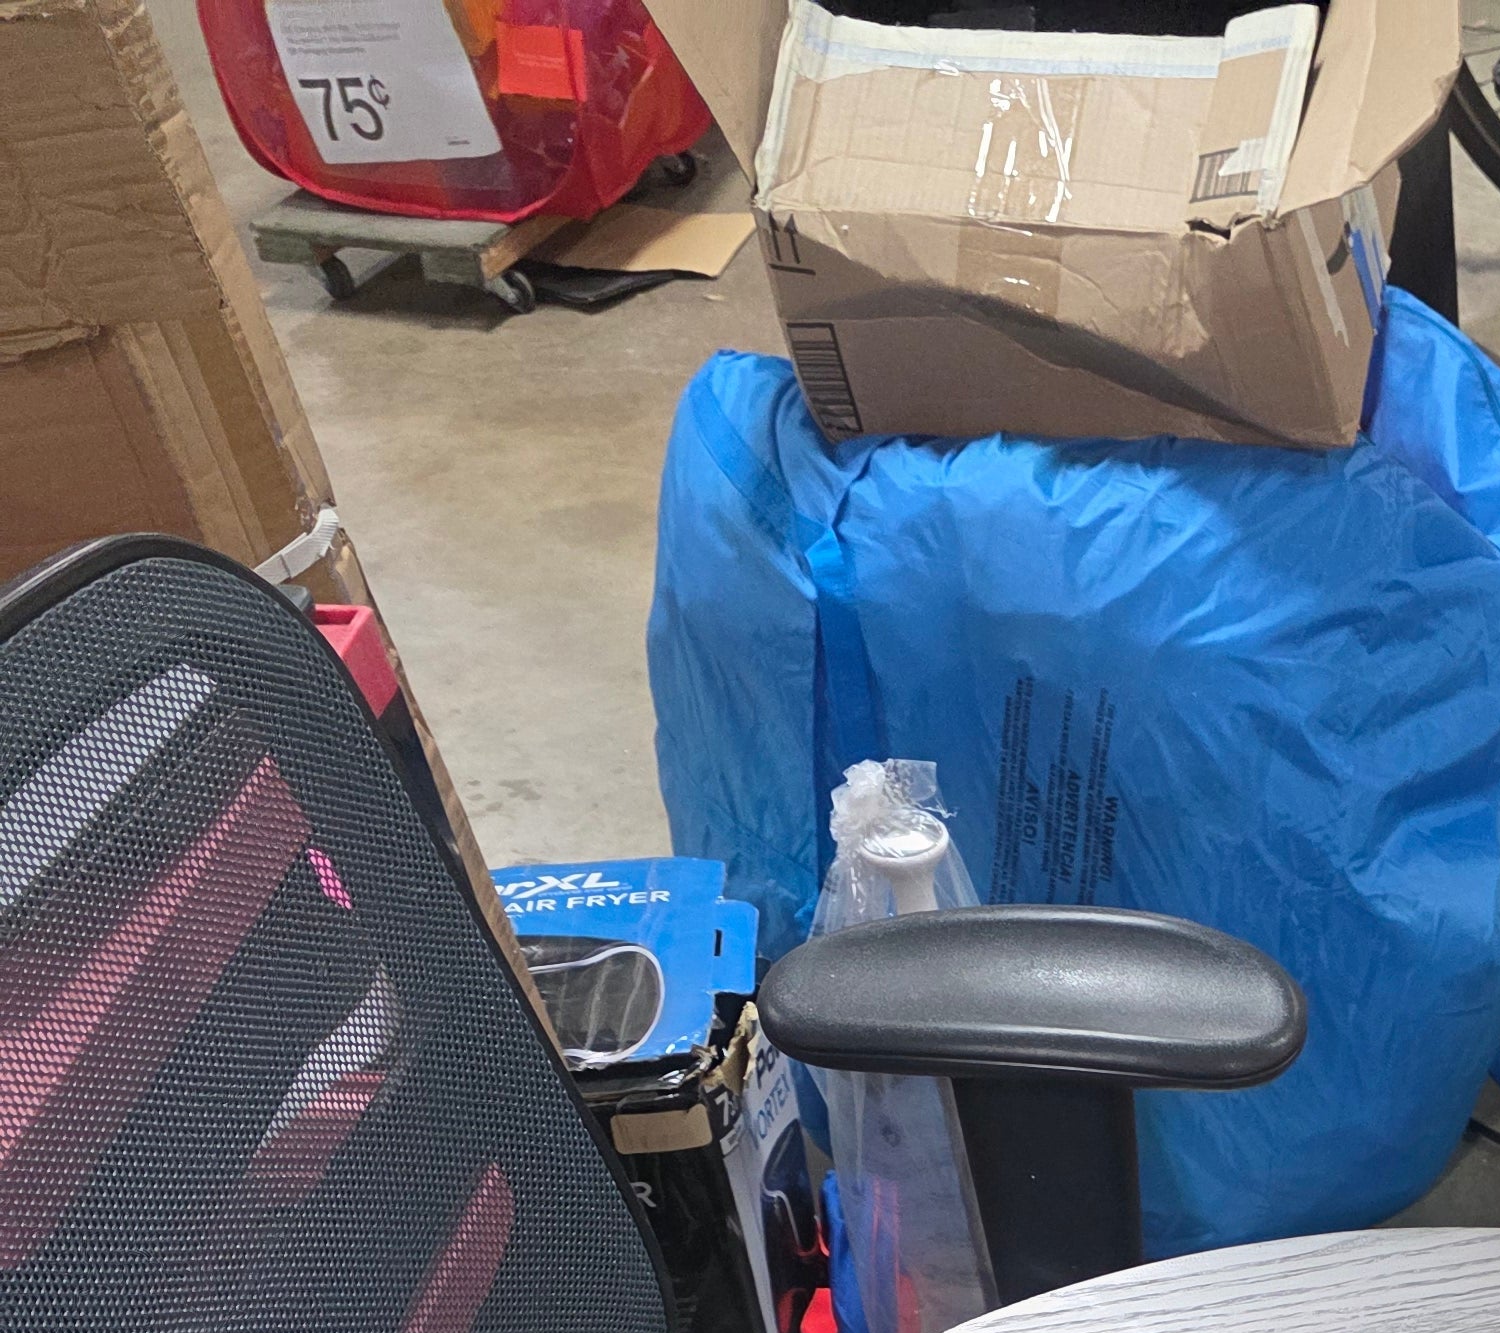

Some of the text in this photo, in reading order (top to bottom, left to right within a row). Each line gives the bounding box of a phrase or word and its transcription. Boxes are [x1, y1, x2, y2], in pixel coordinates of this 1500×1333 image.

[1021, 780, 1041, 847] AVISO!
[1059, 769, 1082, 884] ADVERTENCIA!
[1099, 796, 1118, 882] WARNING!
[504, 899, 556, 914] AIR
[566, 889, 671, 909] FRYER
